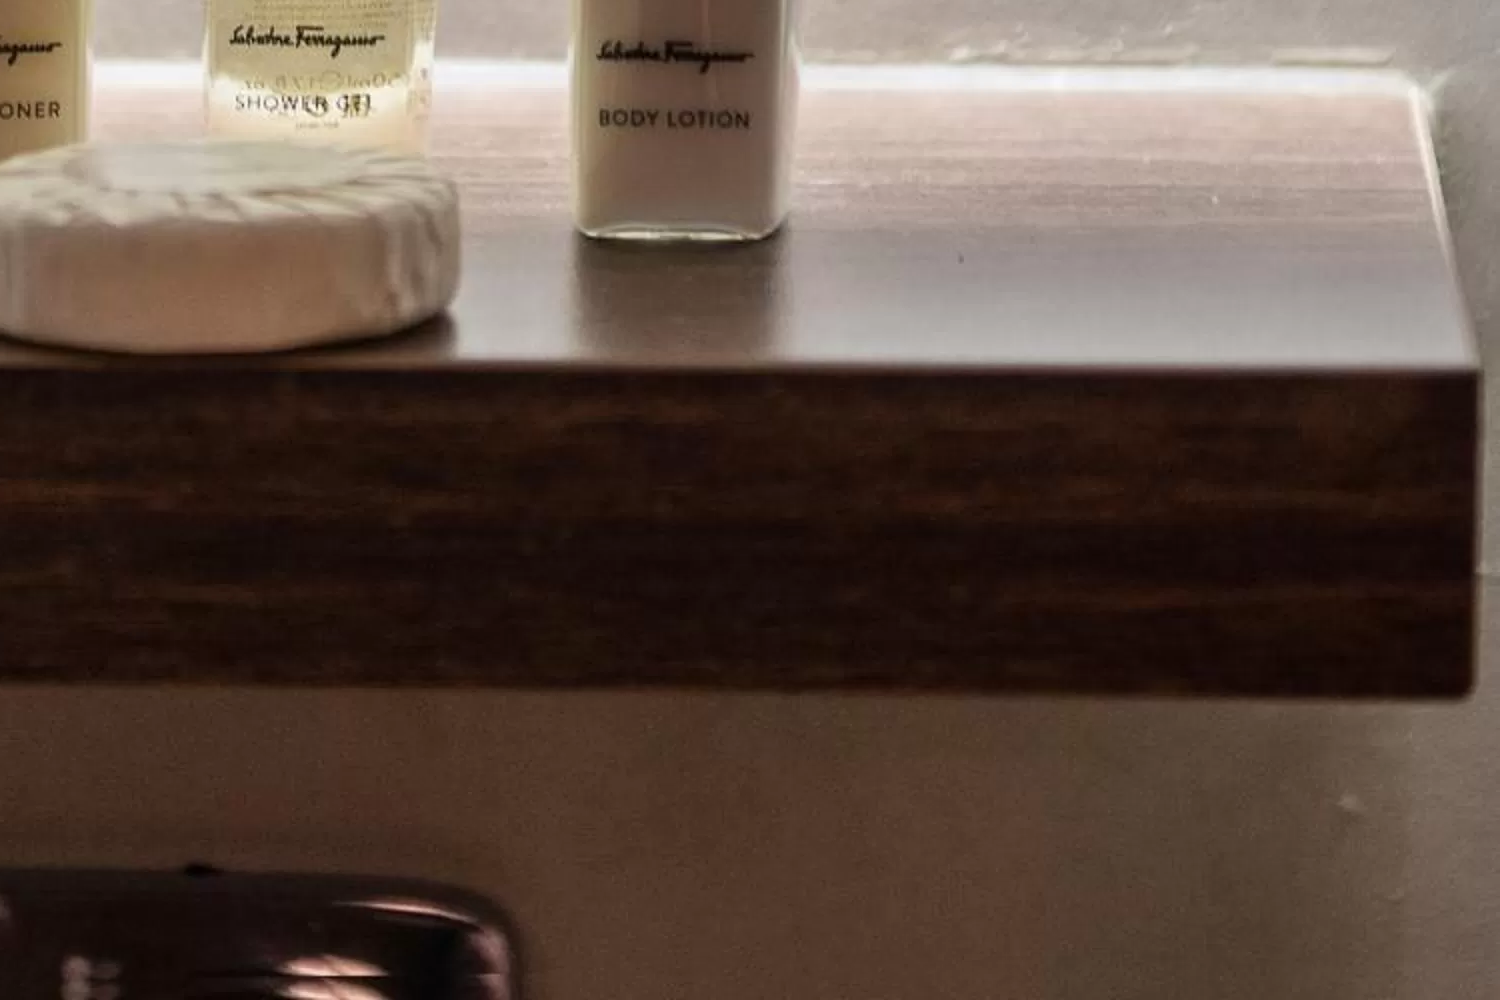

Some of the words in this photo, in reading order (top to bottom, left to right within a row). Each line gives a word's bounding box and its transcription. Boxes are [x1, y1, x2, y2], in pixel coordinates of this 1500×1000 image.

[229, 24, 293, 47] Salvatore
[295, 24, 386, 58] Ferragamo
[235, 93, 329, 111] SHOWER
[598, 108, 659, 128] BODY
[666, 108, 751, 129] LOTION
